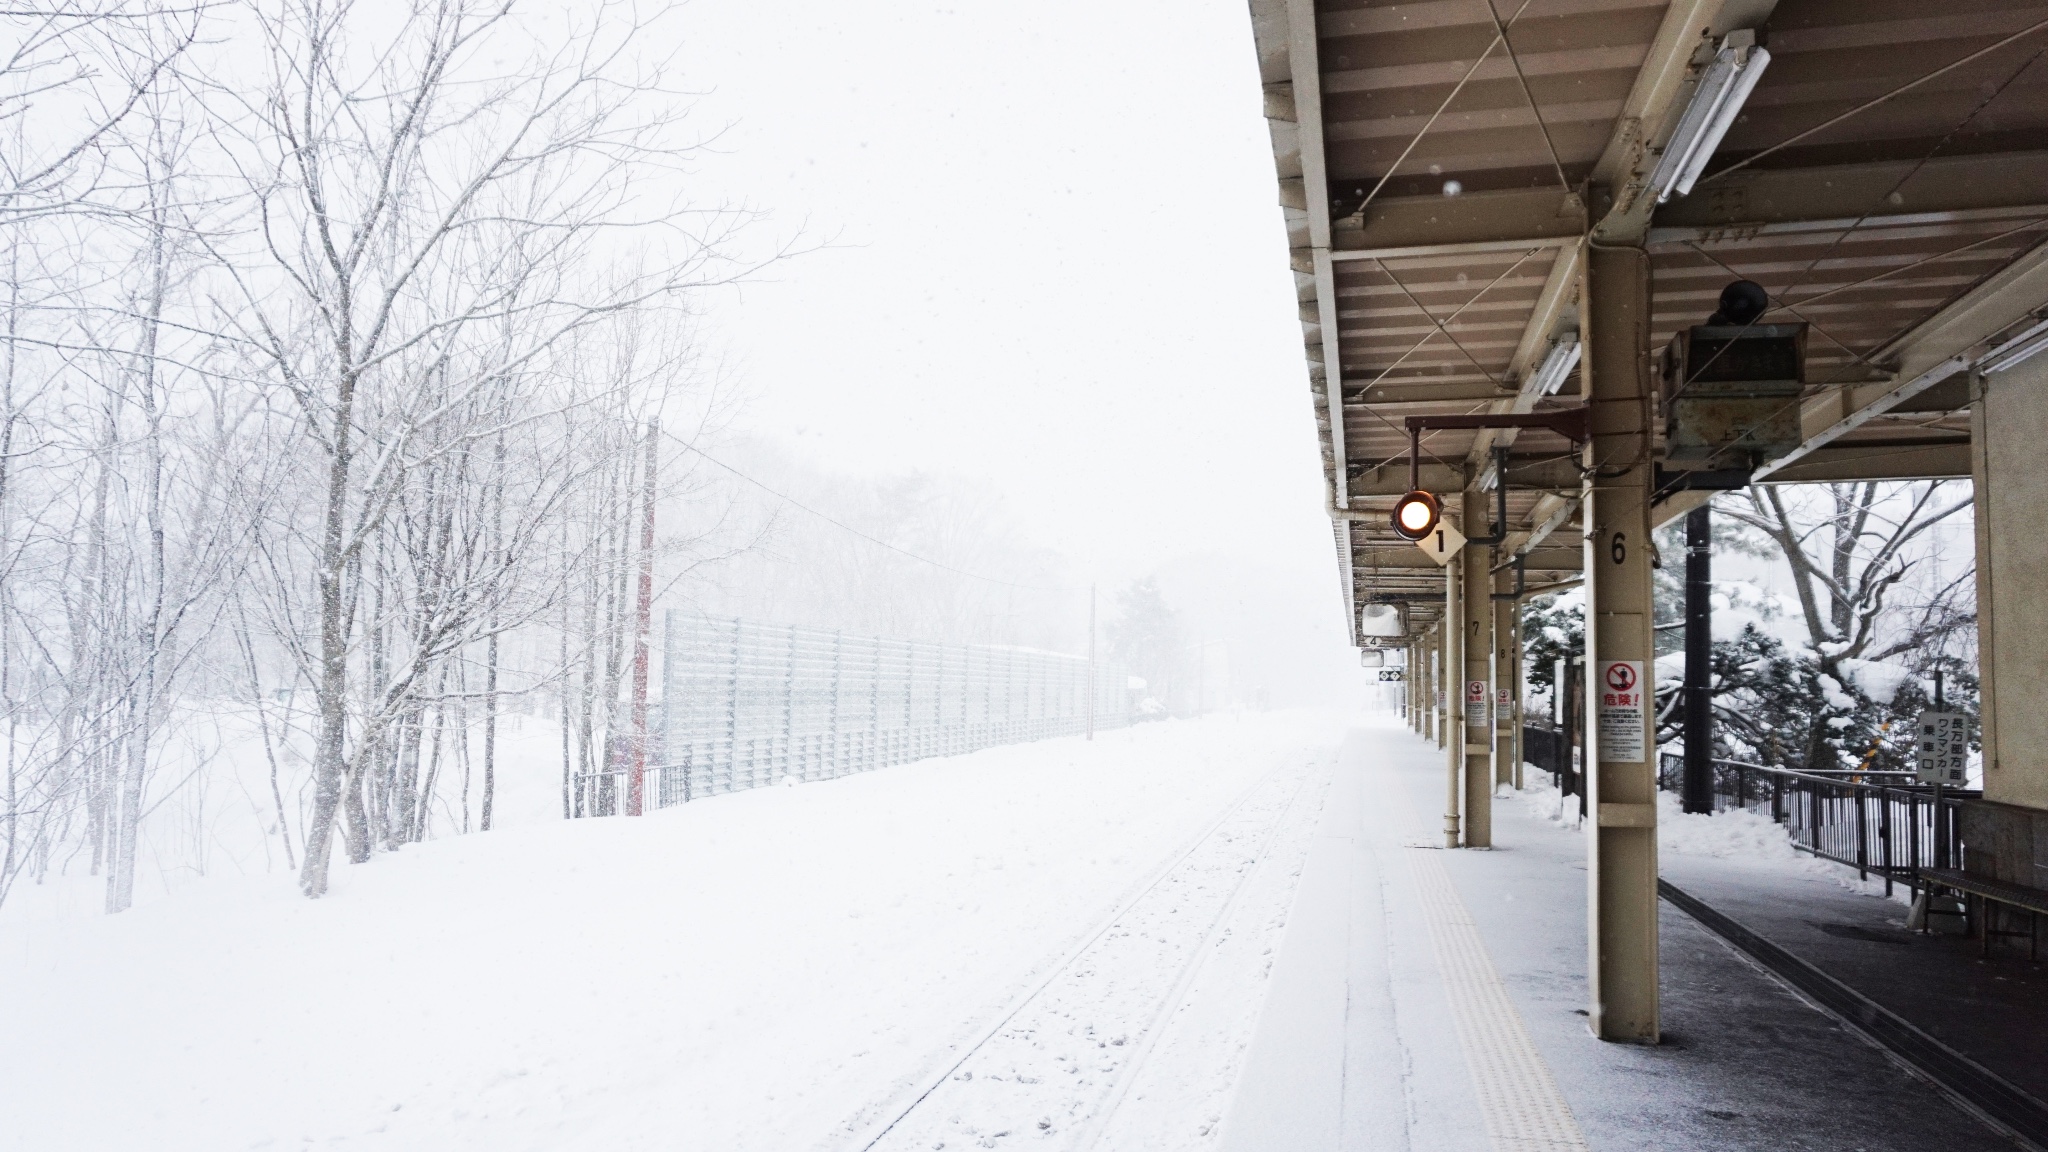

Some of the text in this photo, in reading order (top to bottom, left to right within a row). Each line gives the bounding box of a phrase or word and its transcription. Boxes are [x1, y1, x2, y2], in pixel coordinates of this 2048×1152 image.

[1435, 530, 1444, 552] 1
[1611, 531, 1626, 565] 6
[1369, 634, 1377, 646] 4
[1472, 621, 1479, 636] 7
[1500, 648, 1506, 659] 8
[1922, 725, 1935, 770] 乗車口
[1937, 718, 1949, 777] ワンマンカー
[1949, 717, 1964, 780] 長万部方面
